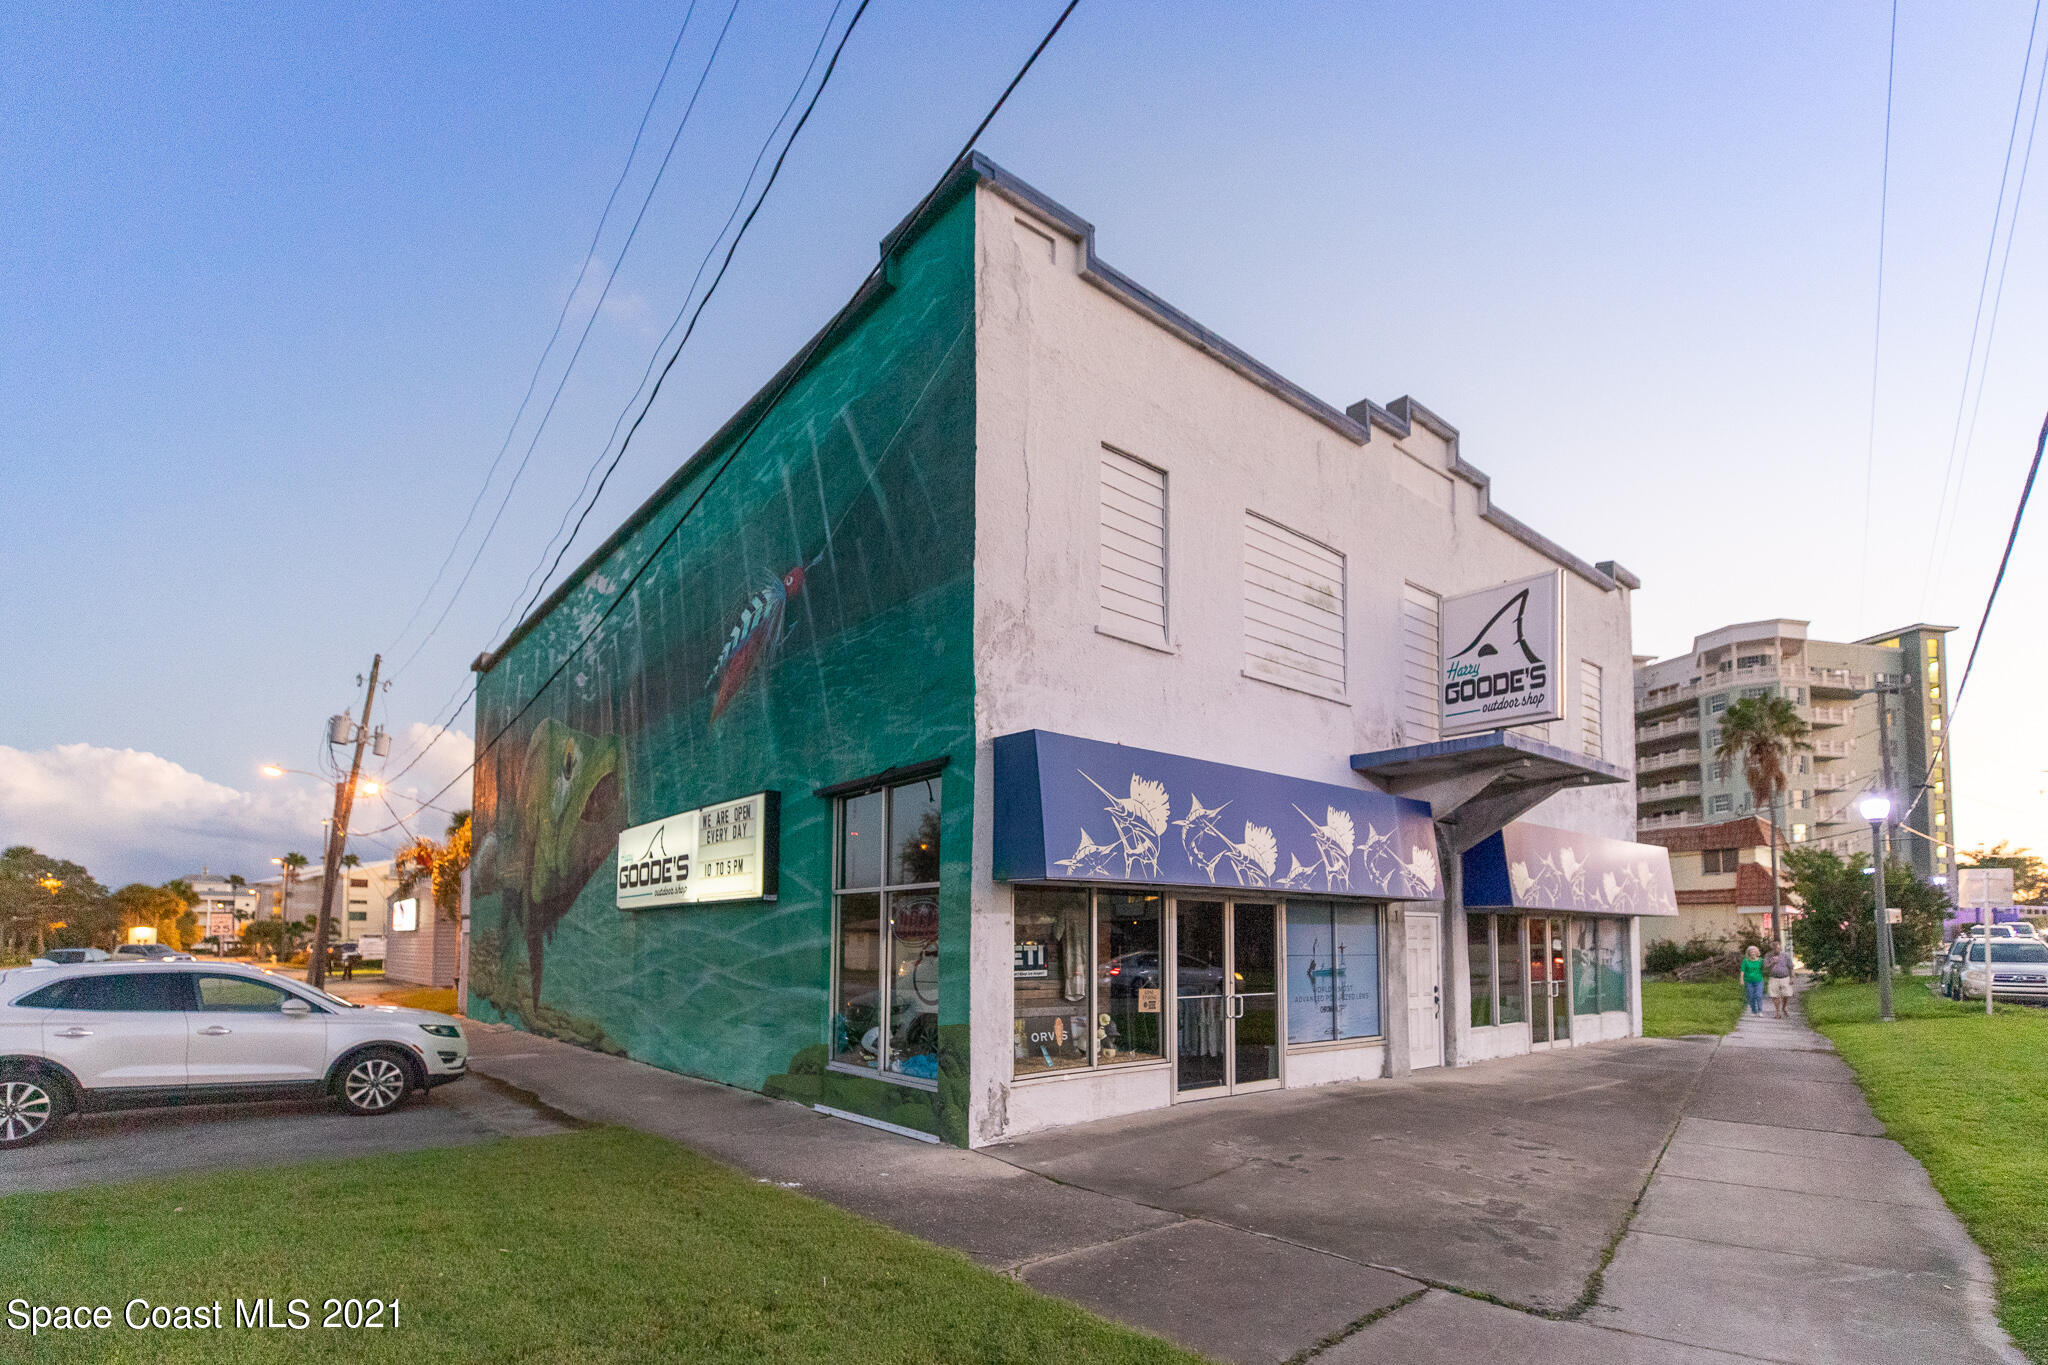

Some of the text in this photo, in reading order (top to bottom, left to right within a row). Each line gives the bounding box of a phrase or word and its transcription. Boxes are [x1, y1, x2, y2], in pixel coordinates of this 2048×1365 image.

[1446, 661, 1480, 681] Harry
[1445, 664, 1547, 705] GOODE'S
[1482, 692, 1545, 713] outdoor shop
[703, 804, 751, 828] WE ARE OPEN
[707, 823, 747, 844] EVERY DAY
[619, 854, 689, 889] GOODE'S
[704, 863, 712, 877] 10
[716, 861, 724, 876] TO
[1014, 945, 1044, 966] ETI
[1031, 1030, 1068, 1043] ORVS
